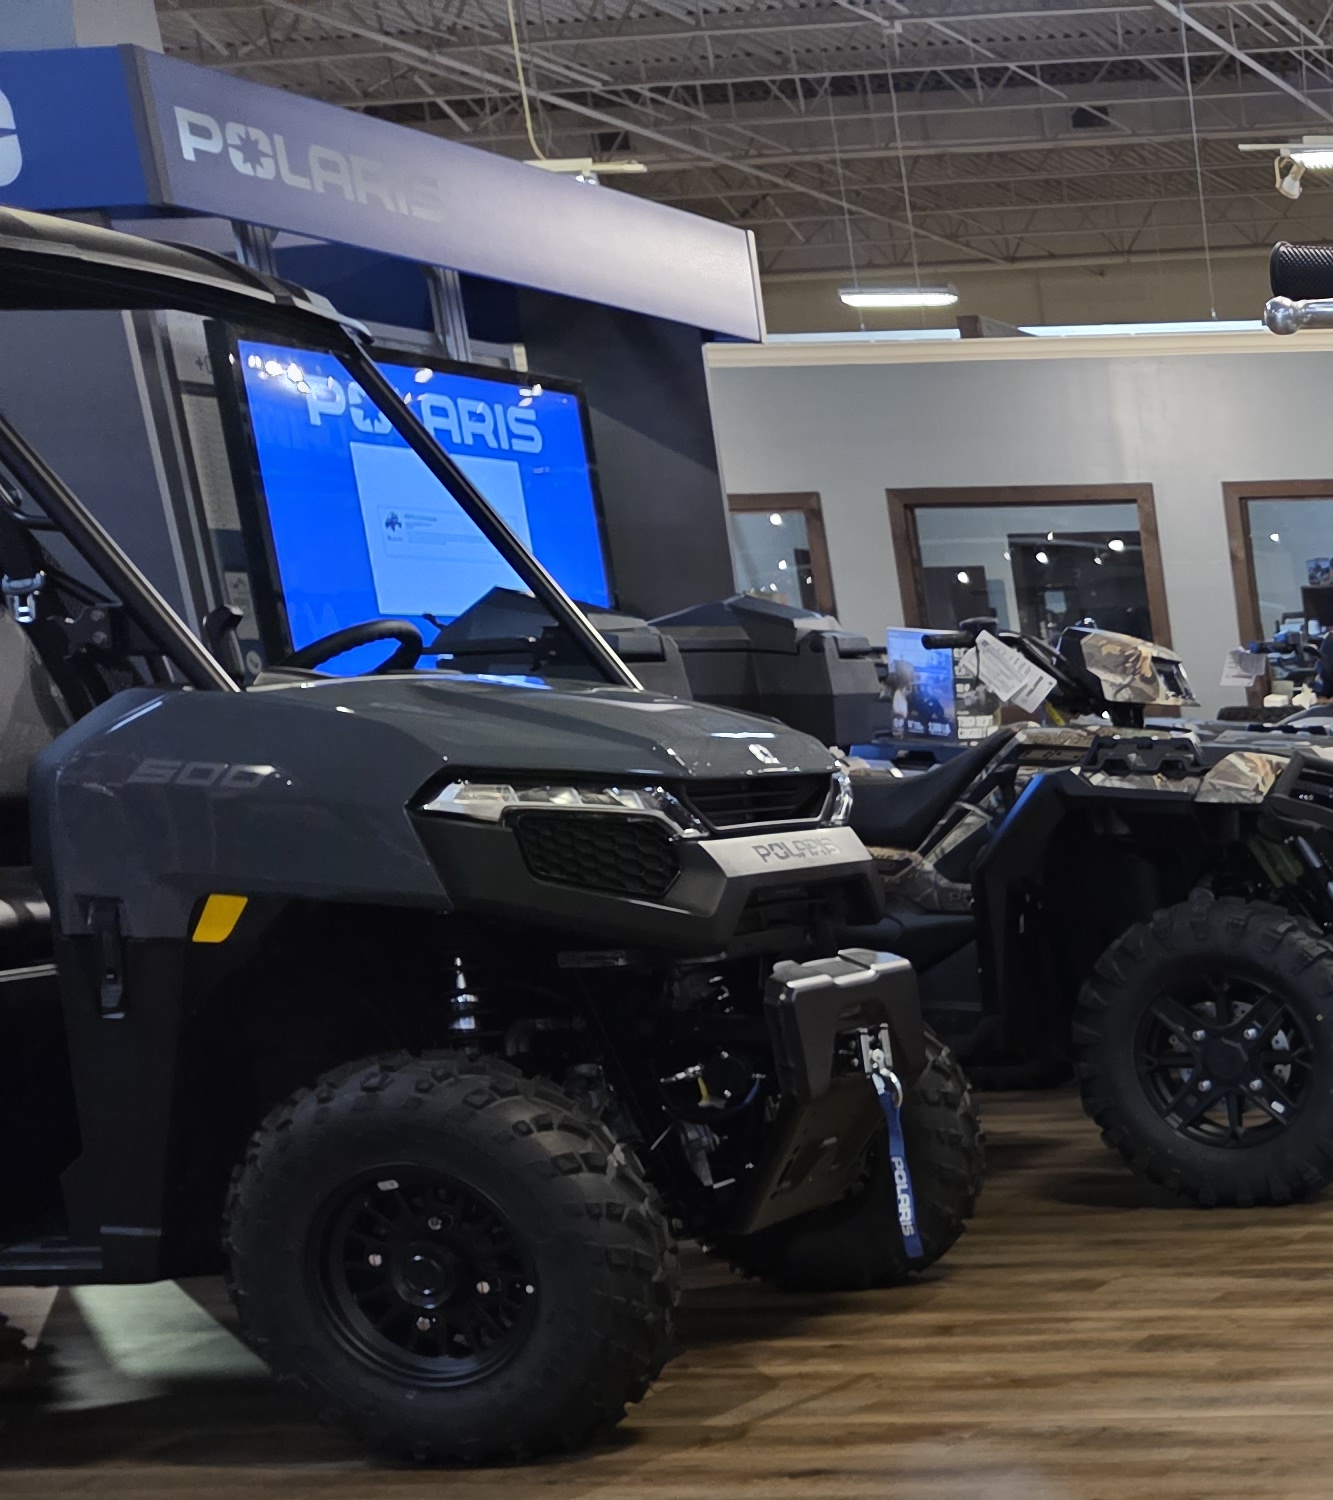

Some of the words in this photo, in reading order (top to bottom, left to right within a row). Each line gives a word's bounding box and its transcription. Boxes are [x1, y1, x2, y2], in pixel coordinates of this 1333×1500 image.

[174, 105, 447, 223] POLARIS
[303, 373, 543, 454] POARIS
[891, 1156, 915, 1237] POLARIS
